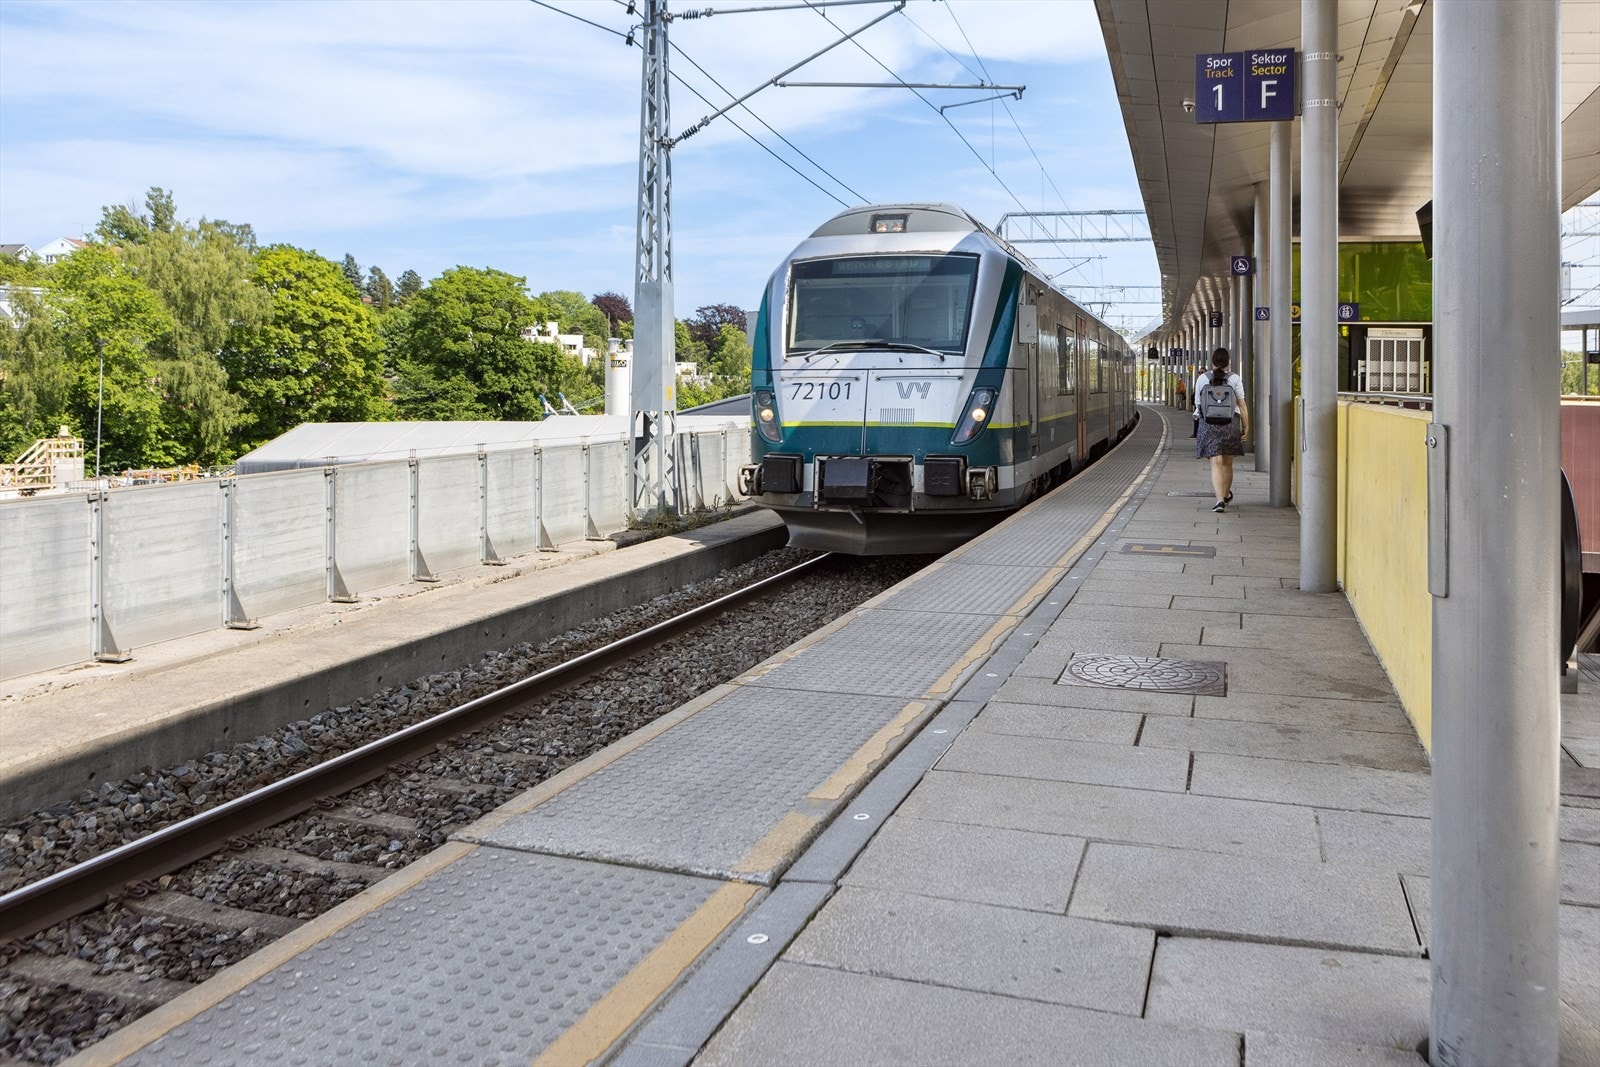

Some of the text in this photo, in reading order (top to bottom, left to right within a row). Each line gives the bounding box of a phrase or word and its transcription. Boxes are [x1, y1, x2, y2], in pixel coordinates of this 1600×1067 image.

[1206, 57, 1232, 69] Spor
[1251, 53, 1287, 65] Sektor
[1205, 67, 1234, 79] Track
[1251, 65, 1287, 76] Sector
[1212, 84, 1223, 111] 1
[1261, 80, 1278, 109] F
[791, 382, 852, 400] 72101
